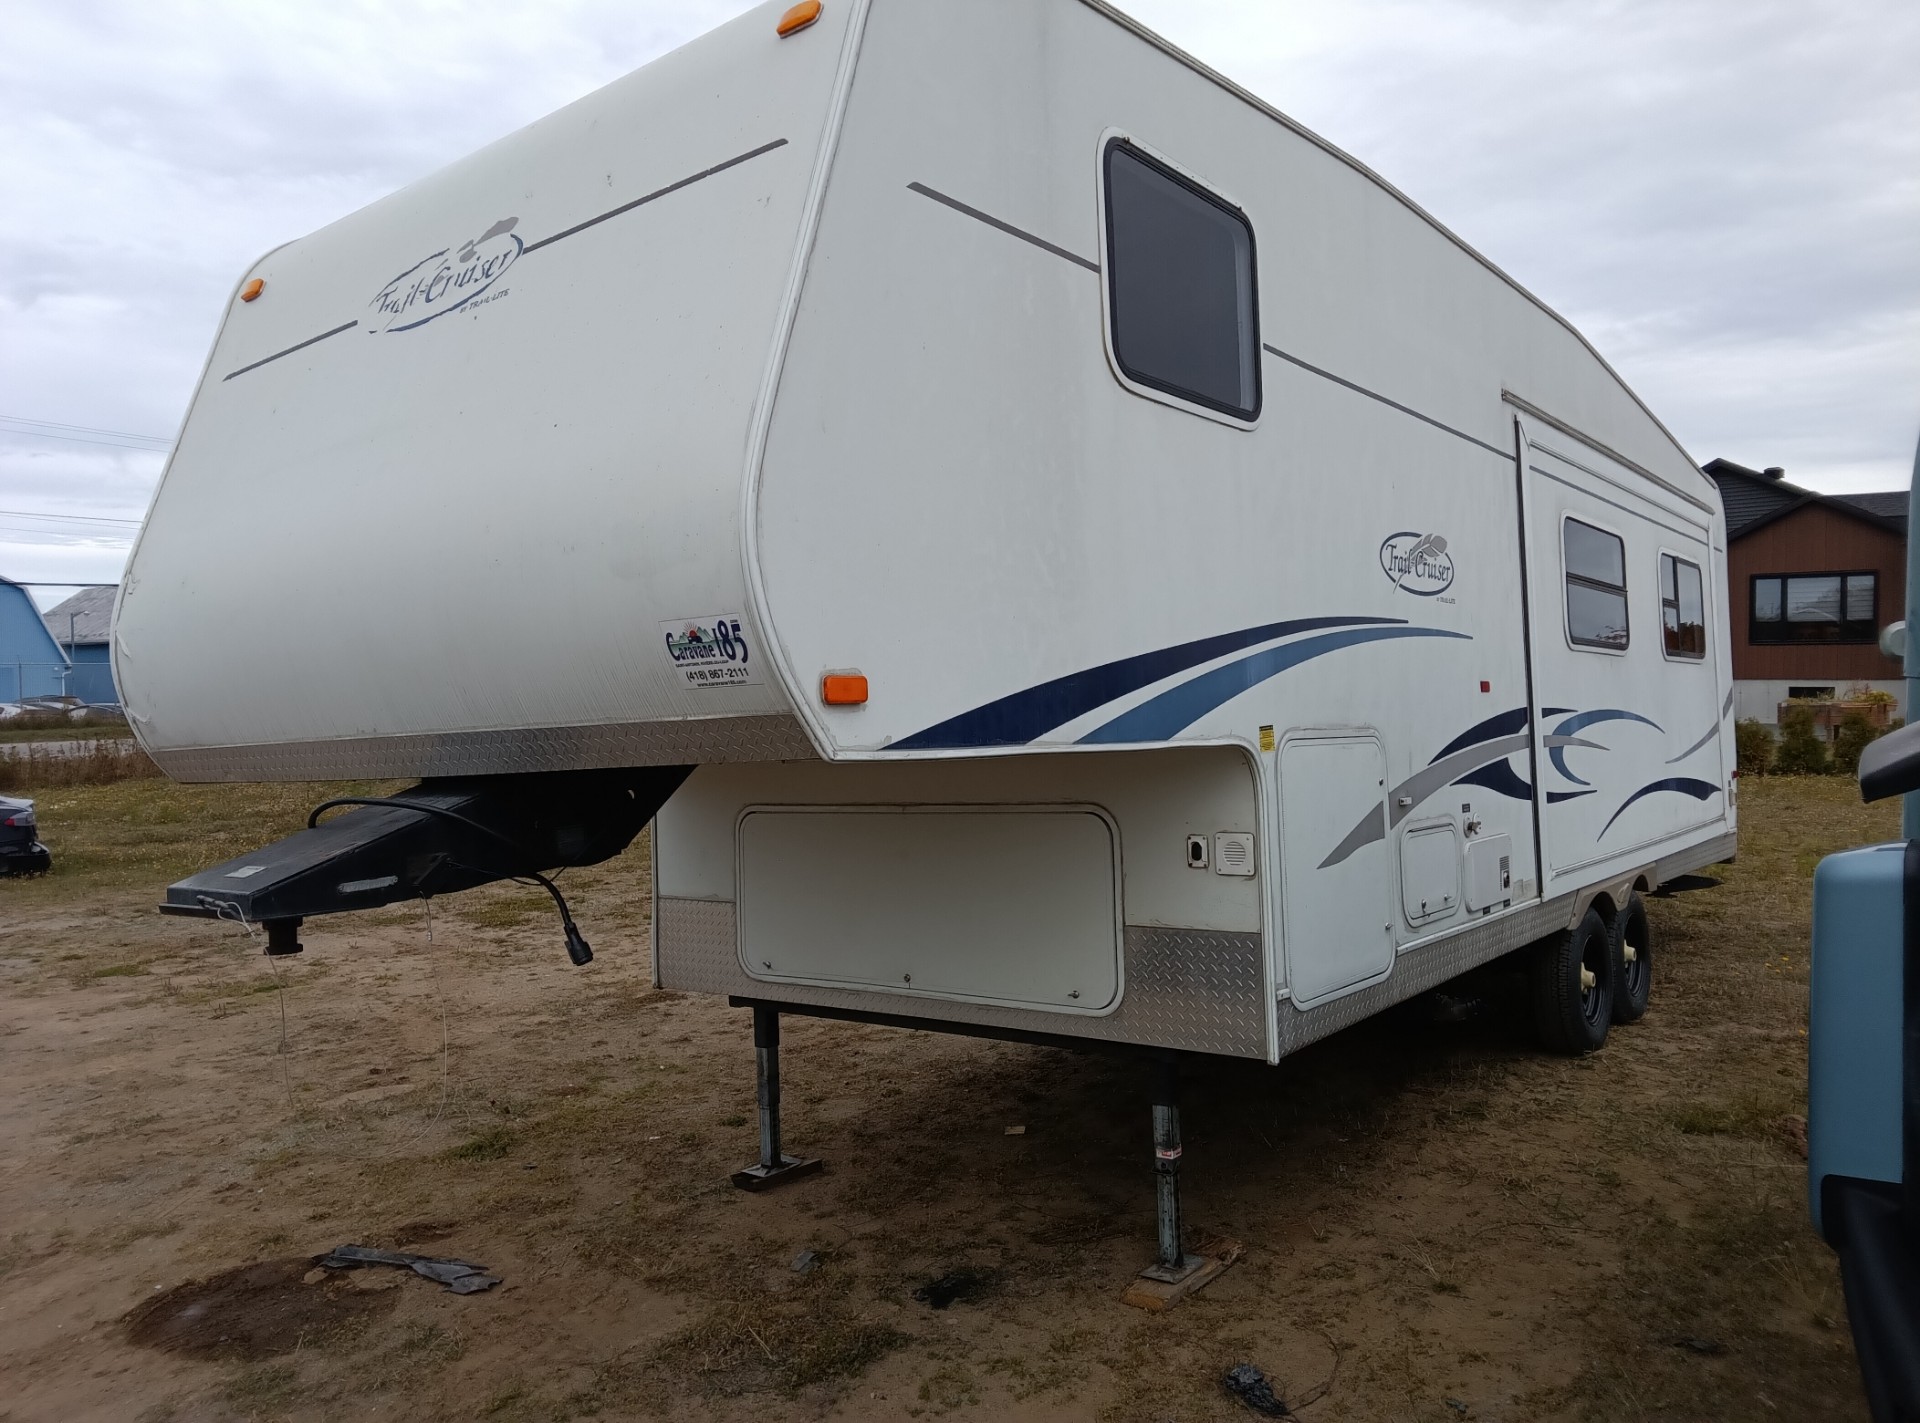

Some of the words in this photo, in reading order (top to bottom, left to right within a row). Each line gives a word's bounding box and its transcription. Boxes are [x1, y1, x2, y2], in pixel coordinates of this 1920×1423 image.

[1415, 550, 1451, 582] Cruiser
[665, 632, 716, 662] Caravane
[711, 619, 749, 664] 185
[686, 670, 708, 683] (418)
